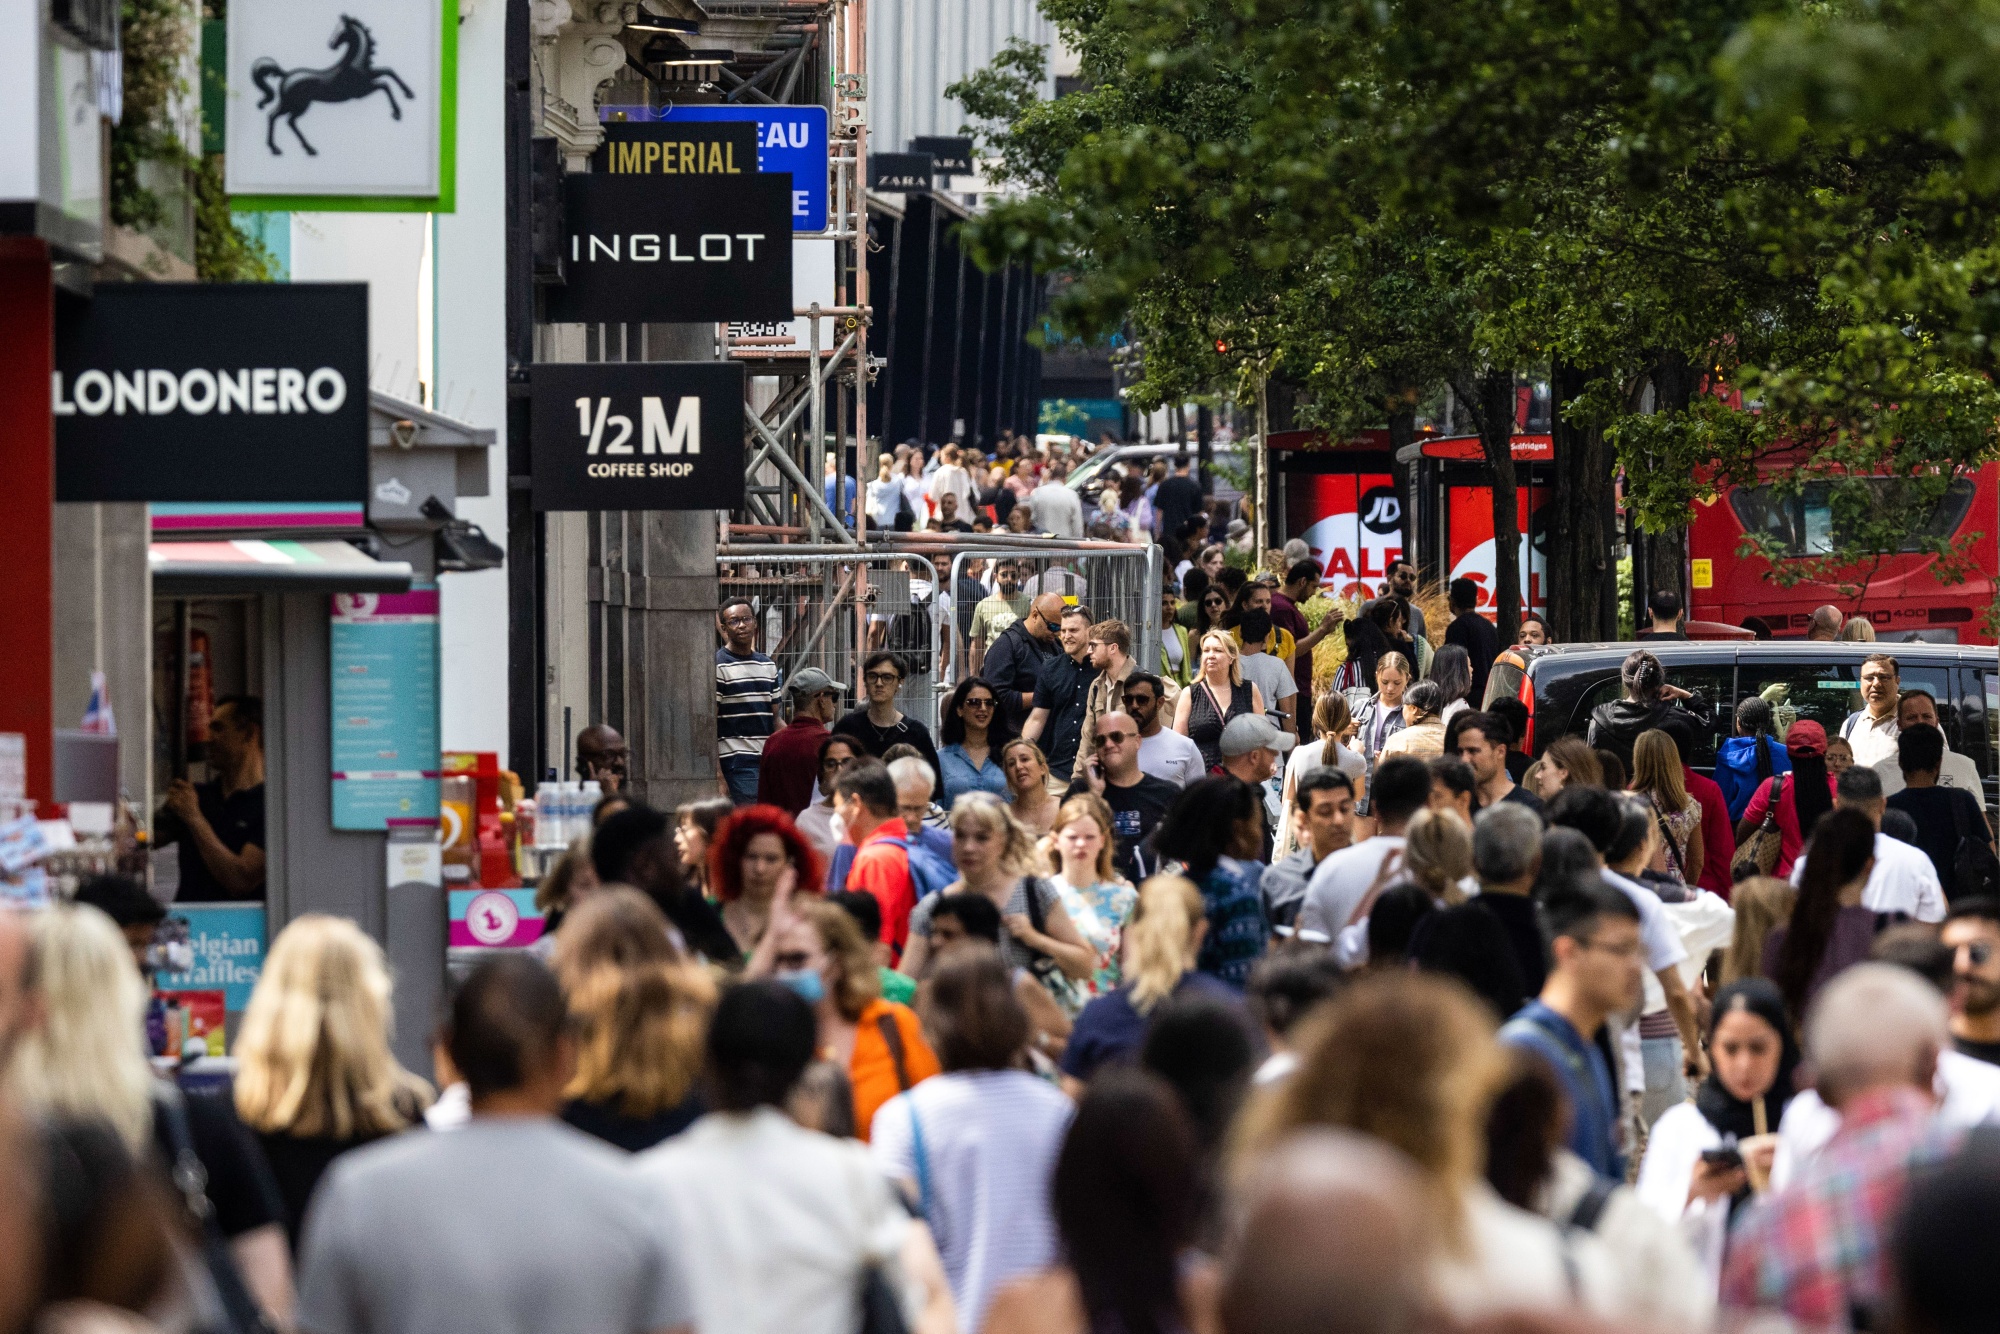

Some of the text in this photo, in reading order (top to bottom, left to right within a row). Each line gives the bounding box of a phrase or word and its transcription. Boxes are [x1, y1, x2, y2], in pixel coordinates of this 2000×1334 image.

[608, 141, 741, 174] IMPERIAL
[933, 159, 966, 168] ARA
[878, 175, 926, 186] ZARA
[572, 234, 765, 262] INGLOT
[51, 367, 347, 416] LONDONERO
[587, 462, 693, 477] COFFEE SHOP
[1363, 496, 1401, 524] JD
[1893, 608, 1927, 618] 400
[189, 931, 259, 961] elgian
